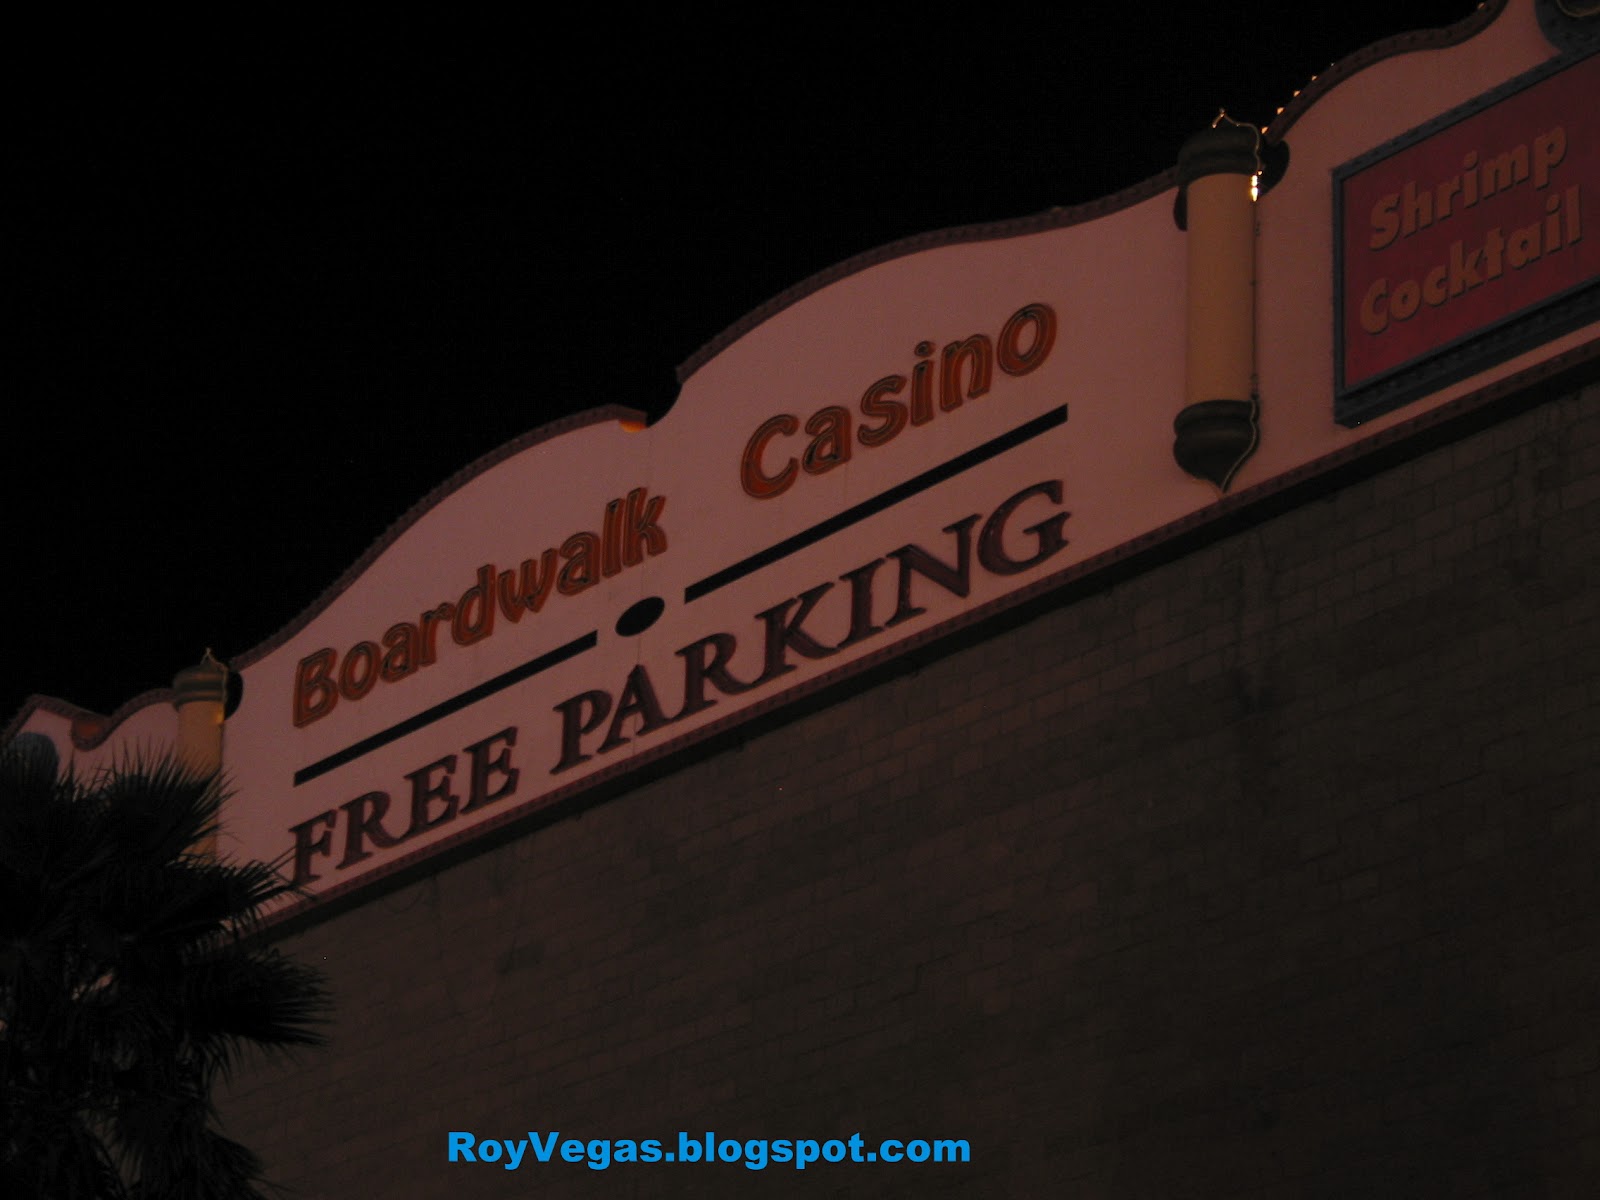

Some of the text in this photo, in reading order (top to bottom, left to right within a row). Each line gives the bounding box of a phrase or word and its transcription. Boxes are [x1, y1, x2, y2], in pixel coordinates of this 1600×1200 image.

[1359, 183, 1583, 335] Cocktail
[1369, 125, 1567, 251] Shrimp
[292, 303, 1058, 728] Boardwalk Casino
[288, 479, 1072, 888] FREE PARKING
